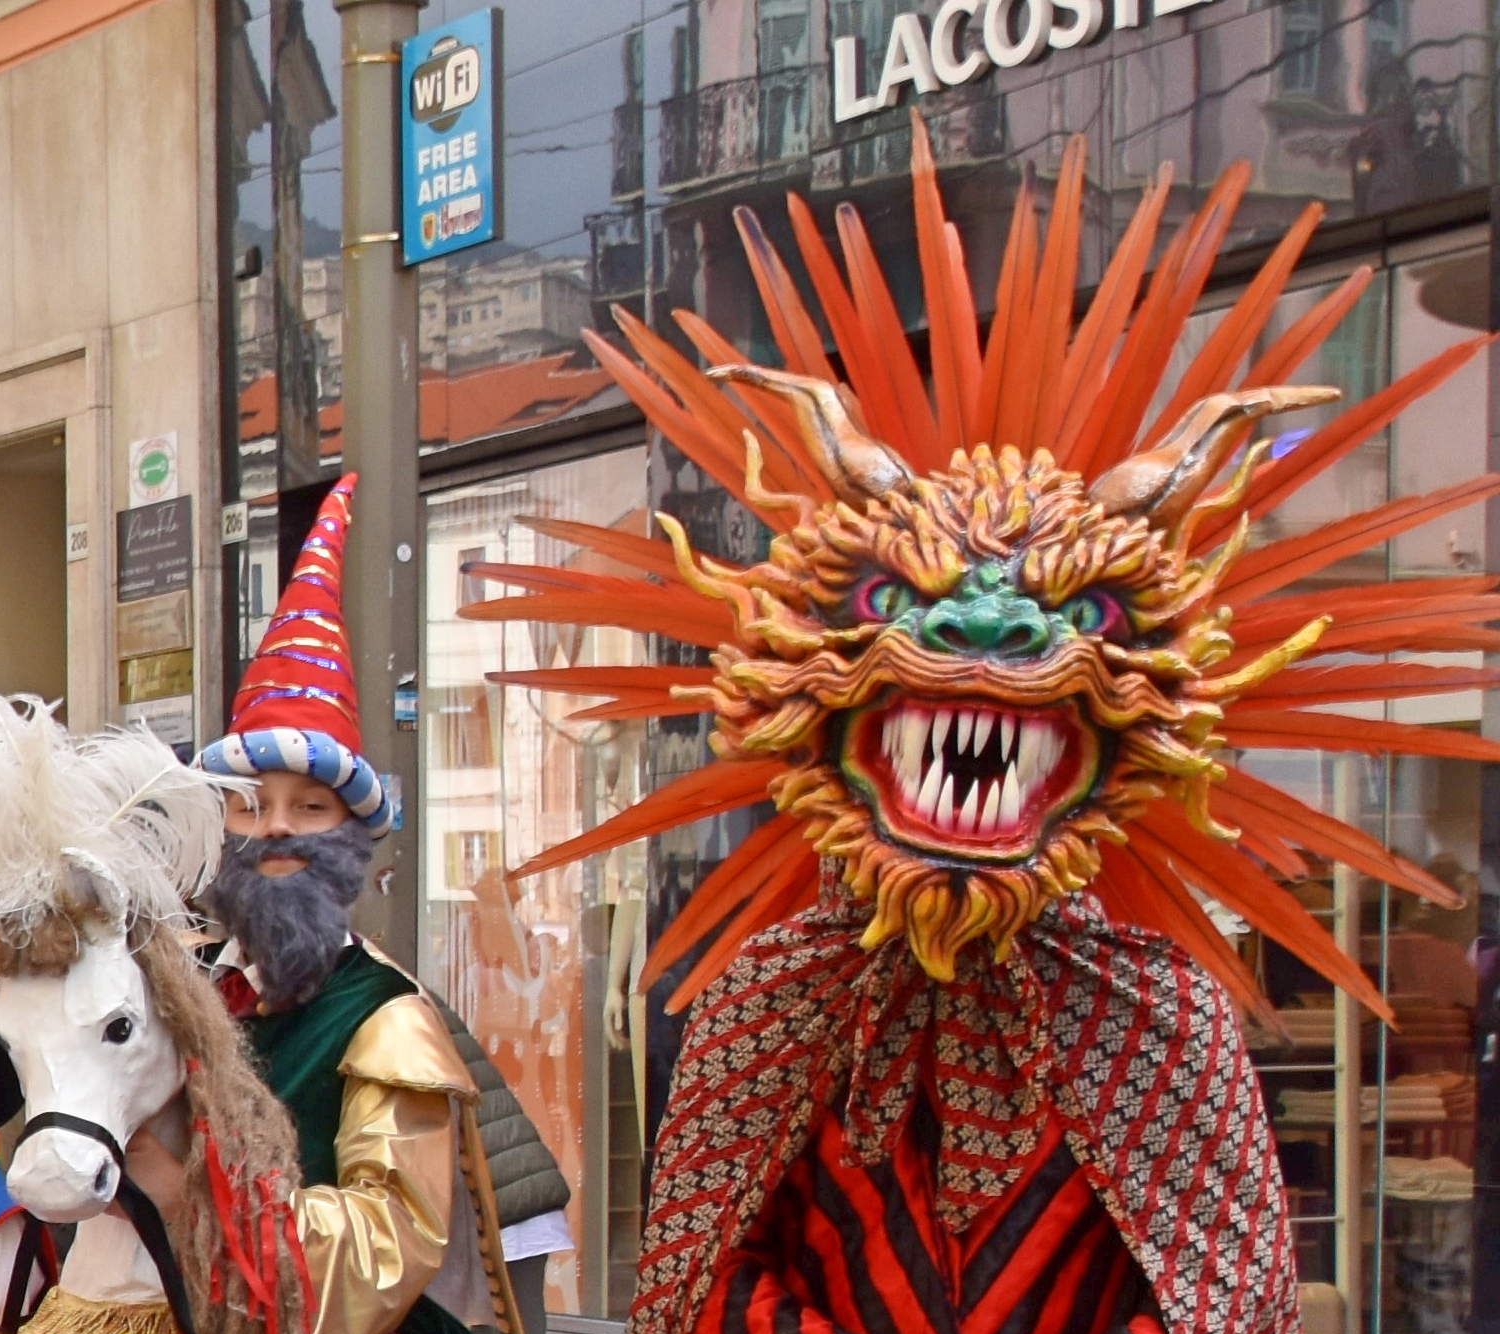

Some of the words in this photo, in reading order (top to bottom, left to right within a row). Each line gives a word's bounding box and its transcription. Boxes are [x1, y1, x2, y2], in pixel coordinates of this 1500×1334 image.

[834, 0, 1212, 123] LACOS
[417, 131, 477, 175] FREE
[417, 164, 477, 206] AREA
[71, 531, 88, 552] 208
[225, 512, 243, 535] 206
